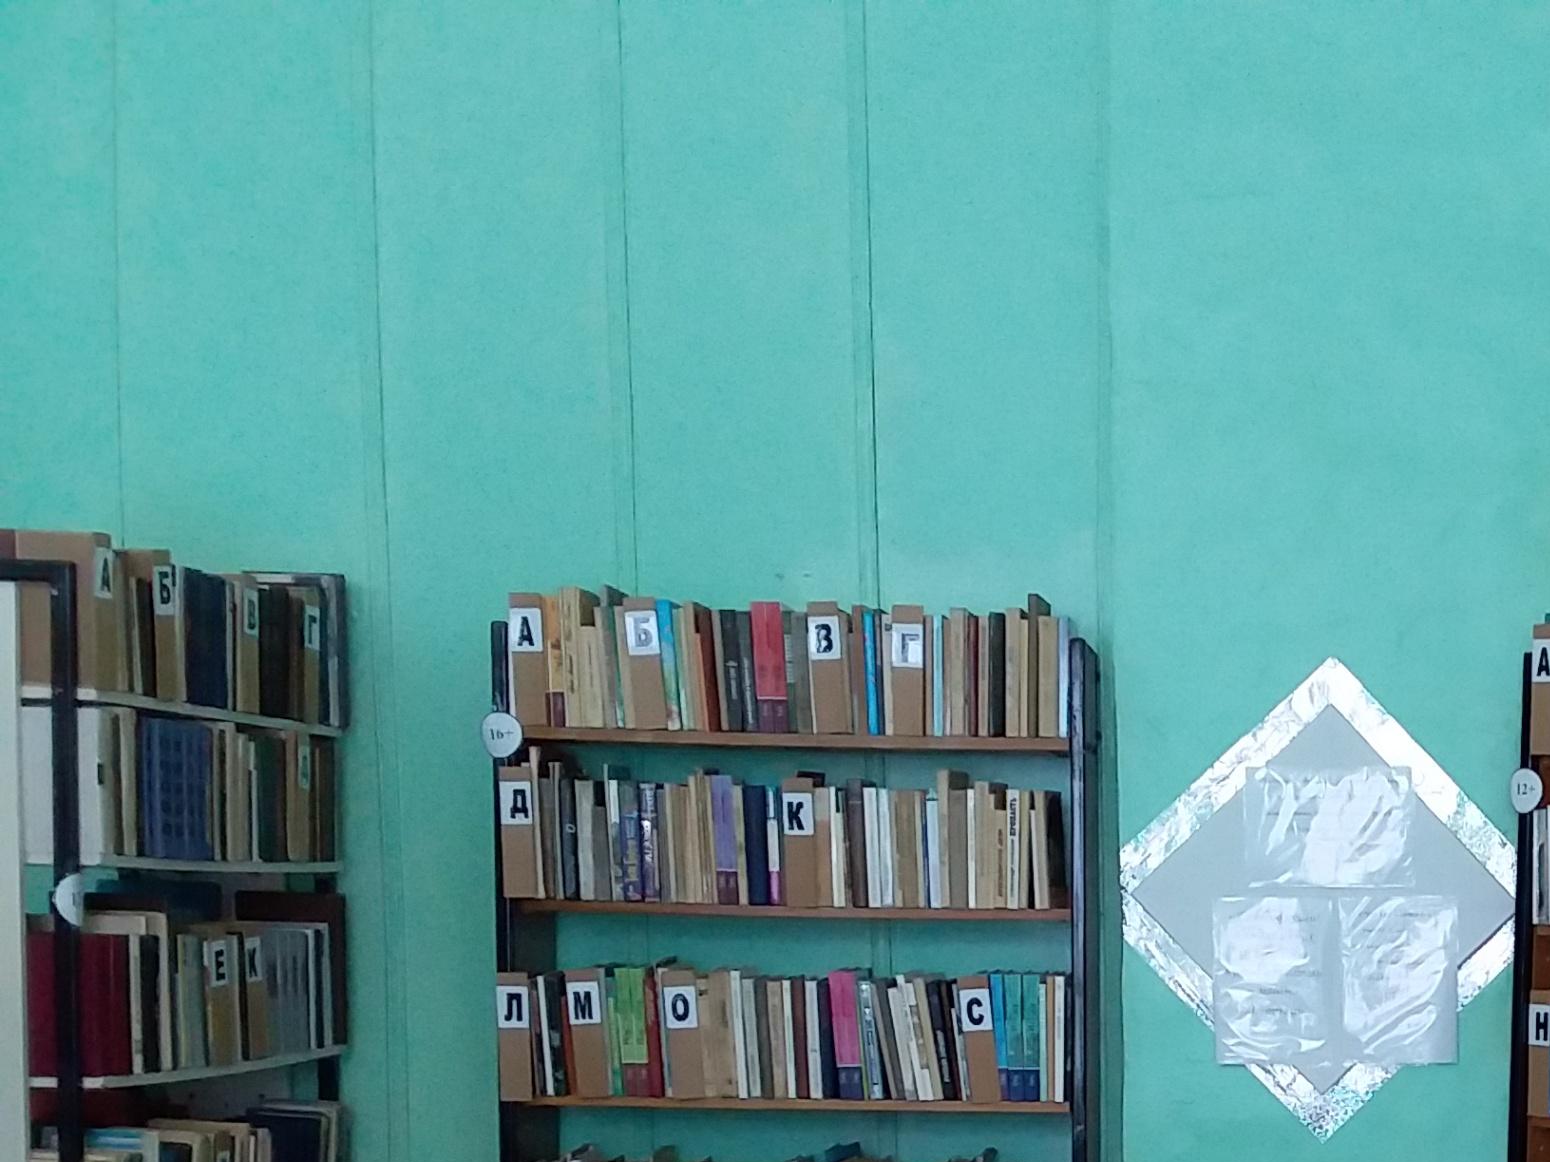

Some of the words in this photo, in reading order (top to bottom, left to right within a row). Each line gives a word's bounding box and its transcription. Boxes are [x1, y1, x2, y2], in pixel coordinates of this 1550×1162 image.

[101, 558, 111, 592] А
[159, 572, 171, 604] Б
[308, 615, 318, 645] Г
[518, 616, 534, 646] А
[634, 617, 652, 648] Б
[815, 624, 833, 653] В
[901, 633, 919, 663] Г
[1537, 647, 1550, 676] А
[511, 789, 529, 819] Д
[1516, 783, 1535, 797] 12+
[787, 802, 804, 830] К
[215, 949, 225, 981] Е
[248, 948, 257, 978] К
[505, 993, 522, 1021] Л
[573, 991, 593, 1020] М
[672, 994, 689, 1021] О
[967, 998, 984, 1025] С
[1536, 1012, 1548, 1041] Н
